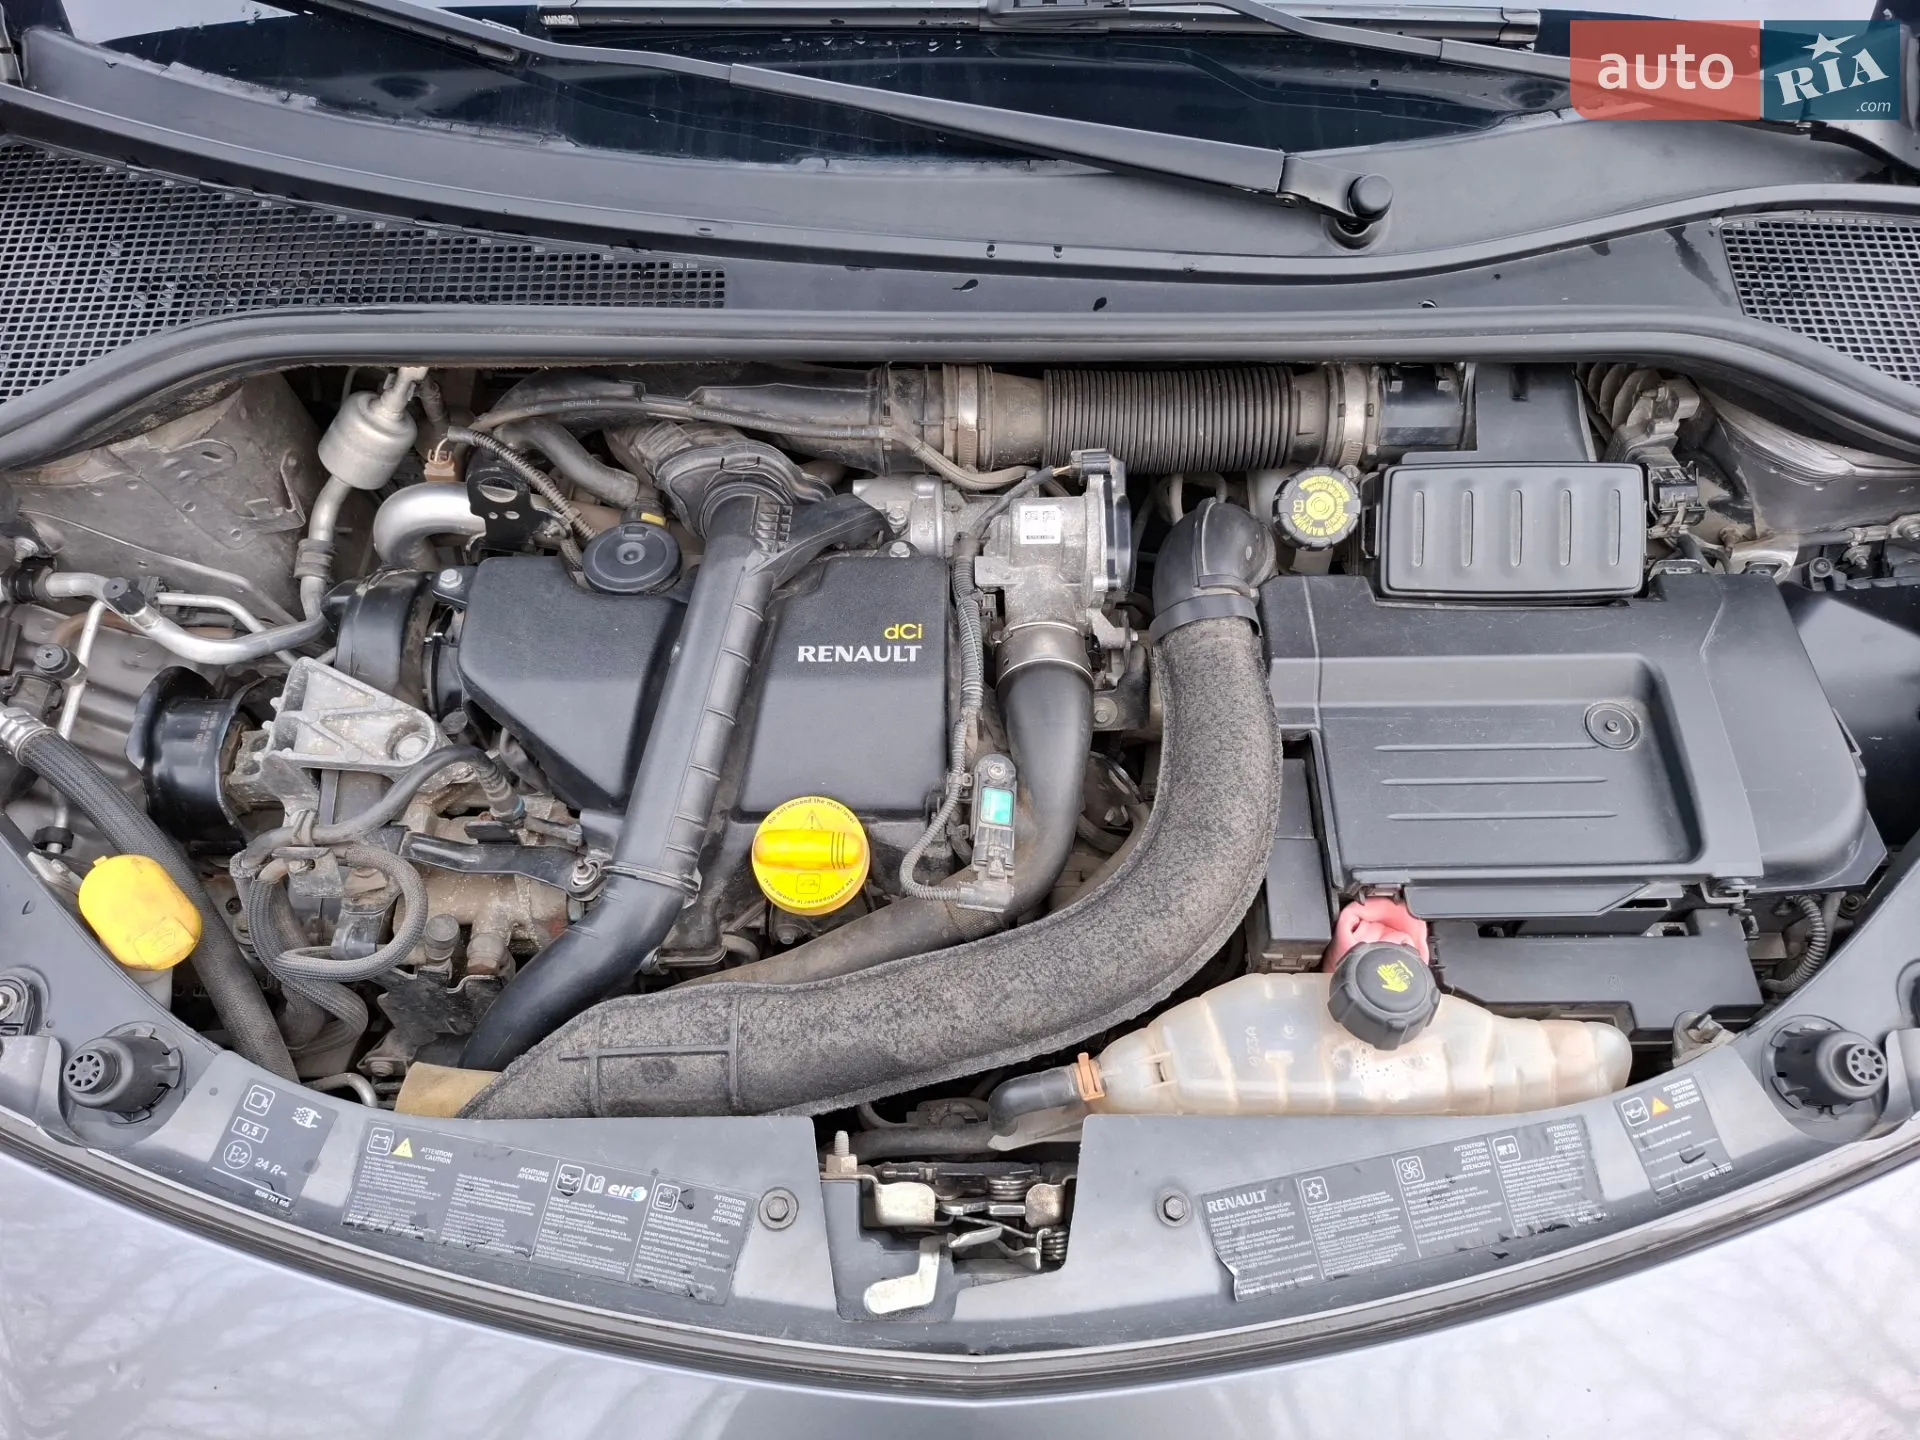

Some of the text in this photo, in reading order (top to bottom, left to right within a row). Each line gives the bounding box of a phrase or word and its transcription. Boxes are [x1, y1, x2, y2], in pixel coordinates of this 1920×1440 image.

[883, 623, 923, 640] dCi
[797, 645, 922, 663] RENAULT
[241, 1122, 258, 1136] 0,5
[1546, 1122, 1576, 1133] ATTENTION
[1553, 1129, 1579, 1138] CAUTION
[420, 1146, 454, 1158] ATTENTION
[1453, 1141, 1486, 1153] ATTENTION
[1461, 1147, 1488, 1158] CAUTION
[226, 1144, 249, 1164] E2
[424, 1154, 452, 1164] CAUTION
[1461, 1154, 1490, 1165] ACHTUNG
[254, 1157, 270, 1170] 24
[519, 1167, 550, 1177] ACHTUNG
[607, 1184, 634, 1198] elf
[714, 1194, 747, 1206] ATTENTION
[1206, 1188, 1267, 1214] RENAULT
[718, 1202, 745, 1213] CAUTION
[714, 1208, 743, 1220] ACHTUNG
